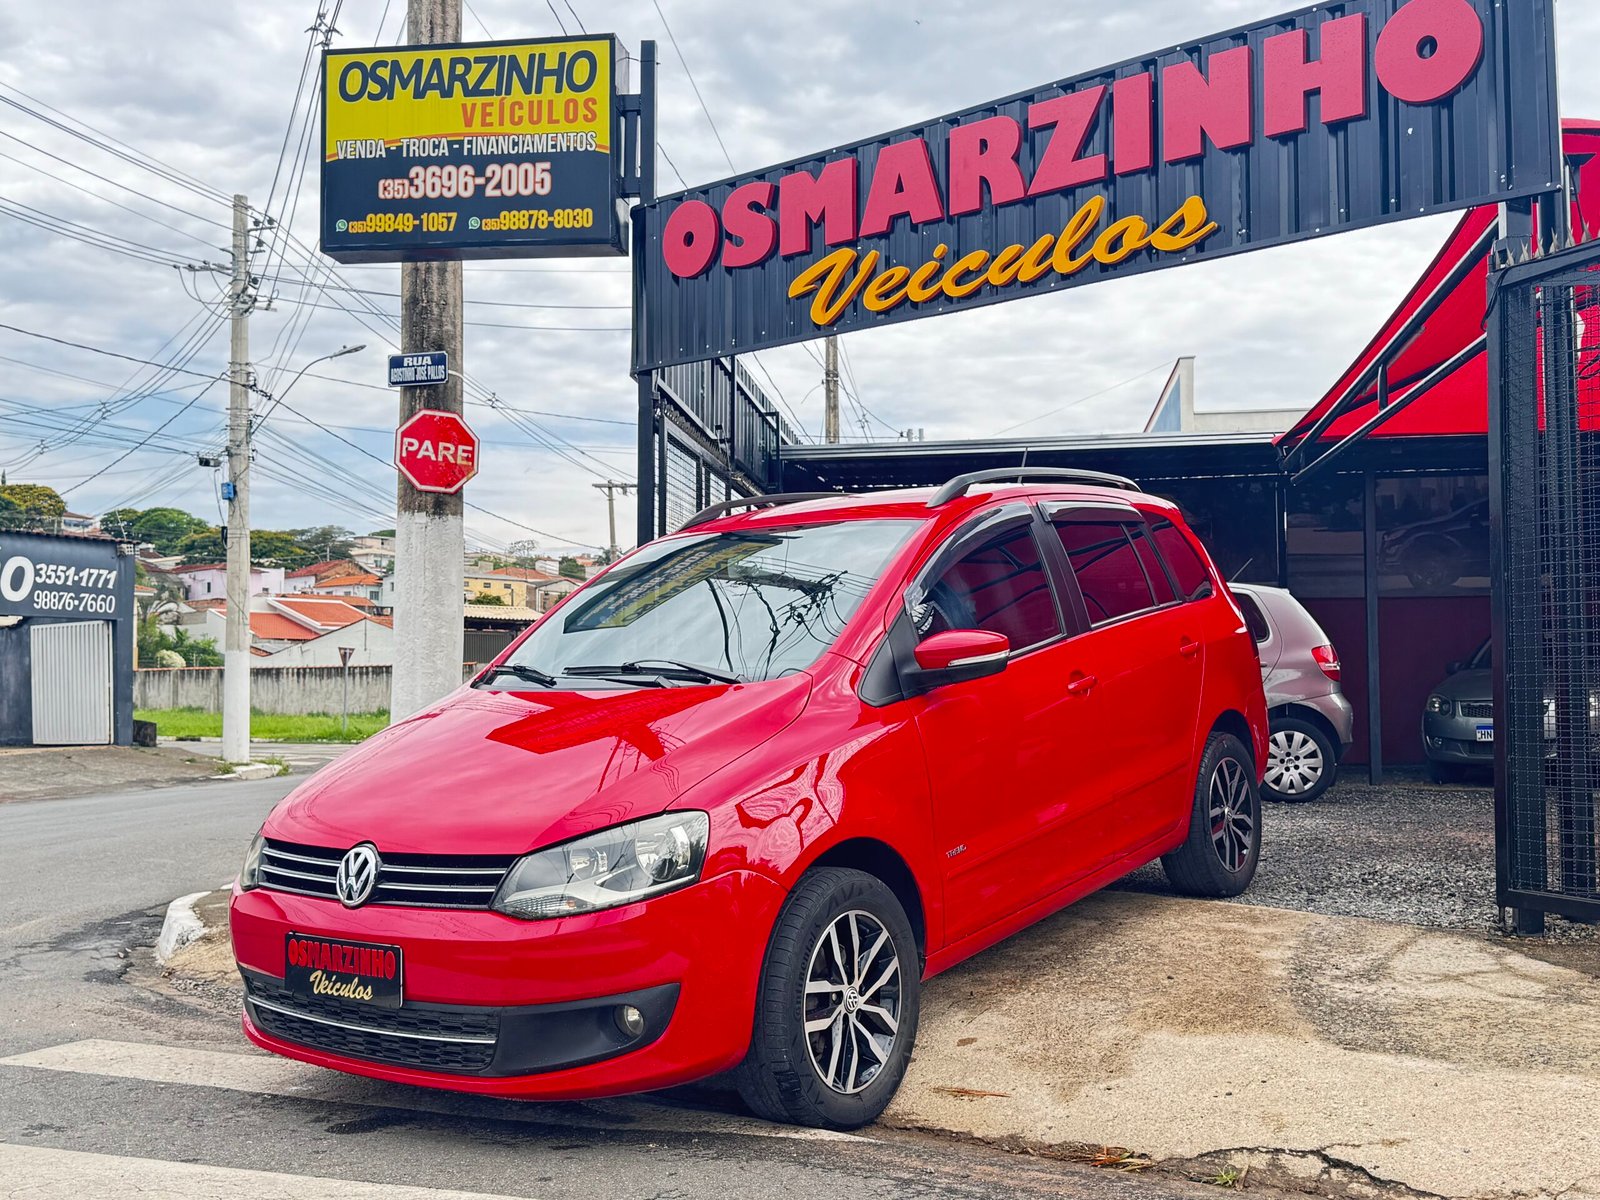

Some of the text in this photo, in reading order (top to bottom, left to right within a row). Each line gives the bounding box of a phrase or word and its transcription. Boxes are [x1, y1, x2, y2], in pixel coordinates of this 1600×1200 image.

[338, 49, 598, 103] OSMARZINHO
[460, 96, 598, 128] VEÍCULOS
[336, 138, 386, 160] VENDA
[400, 137, 449, 158] TROCA
[463, 131, 597, 156] FINANCIAMENTOS
[663, 0, 1484, 279] OSMARZINHO
[403, 356, 432, 367] RUA
[401, 437, 473, 466] PARE
[0, 555, 35, 602] O
[287, 938, 396, 981] OSMARZINHO
